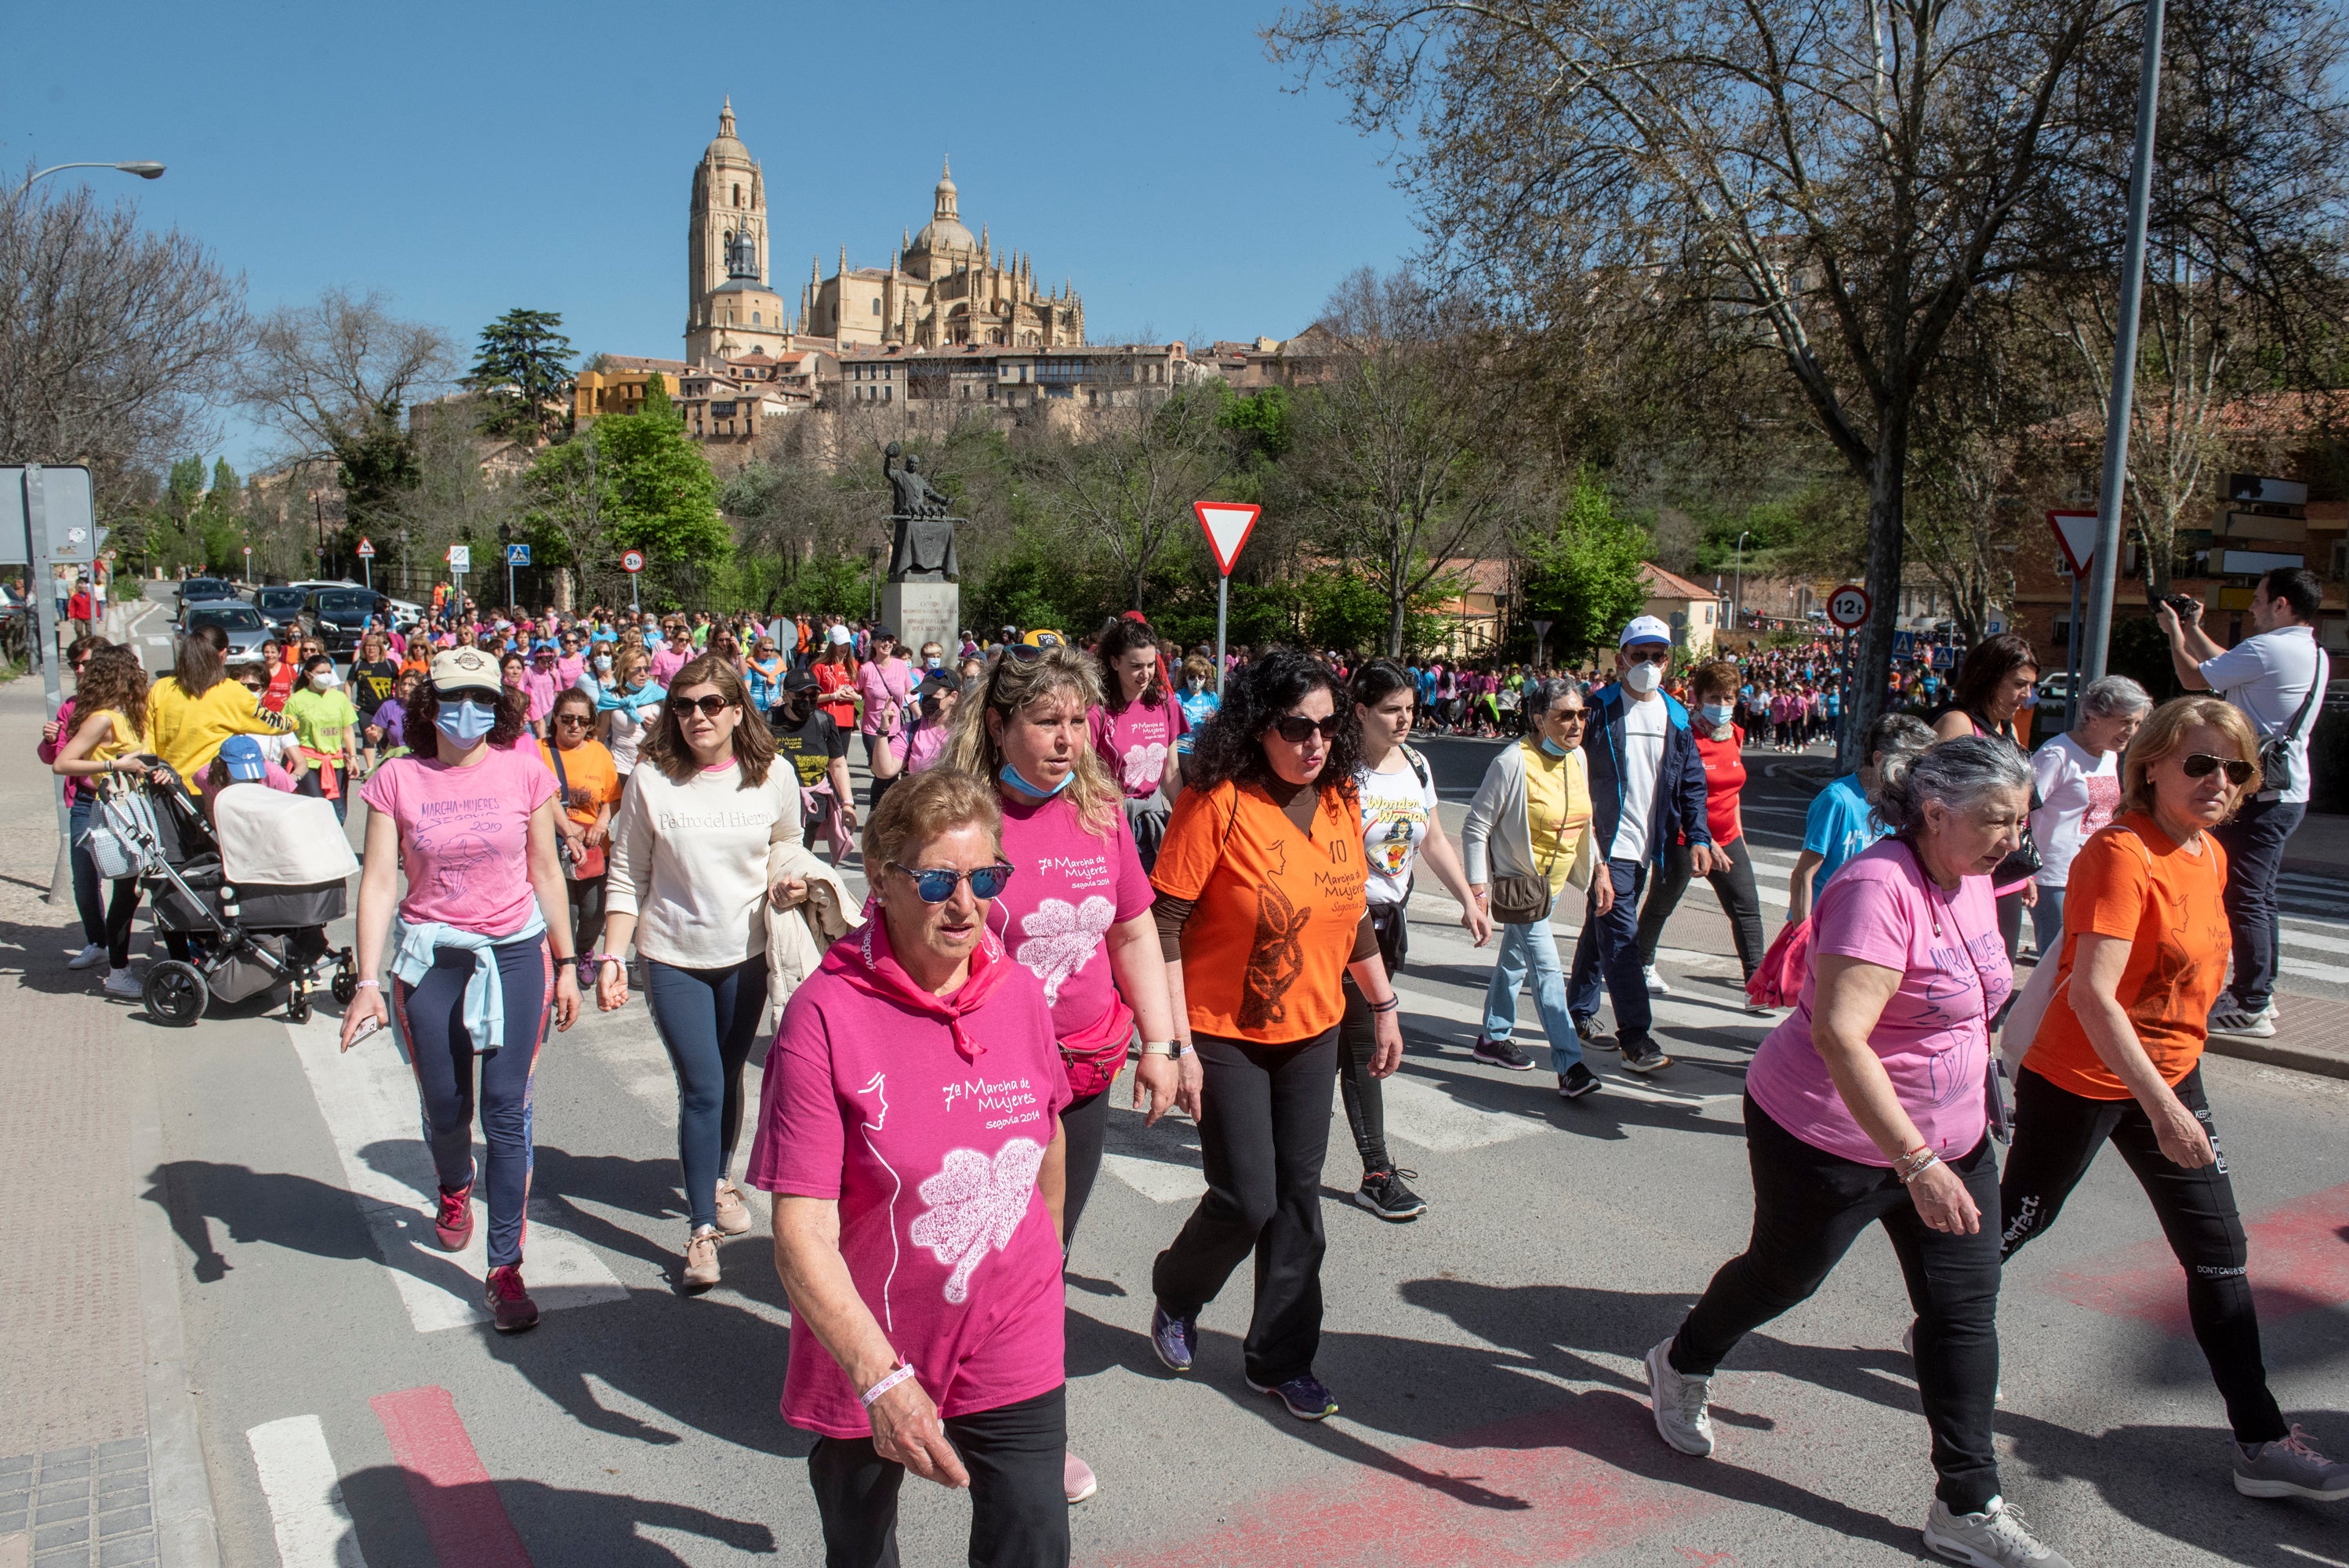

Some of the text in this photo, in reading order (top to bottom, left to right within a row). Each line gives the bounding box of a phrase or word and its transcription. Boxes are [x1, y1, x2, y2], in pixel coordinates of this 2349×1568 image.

[421, 797, 499, 818] MARCHA MUJERES
[1367, 795, 1421, 810] Wonder
[659, 811, 772, 829] Pedro del Hierro
[1378, 809, 1428, 824] Woman
[470, 821, 502, 833] 2019
[1329, 839, 1347, 864] 10
[1055, 856, 1095, 870] Marcha
[1096, 855, 1106, 864] de
[1066, 866, 1108, 880] Mujeres
[1314, 871, 1356, 887] Marcha
[1332, 901, 1358, 917] Segovia
[861, 932, 877, 971] segovi
[1986, 978, 2012, 994] 20
[965, 1077, 1018, 1100] Marcha
[1020, 1077, 1030, 1089] de
[978, 1093, 1036, 1113] Mujeres
[1019, 1110, 1040, 1123] 2014
[2197, 1265, 2218, 1275] DON'T
